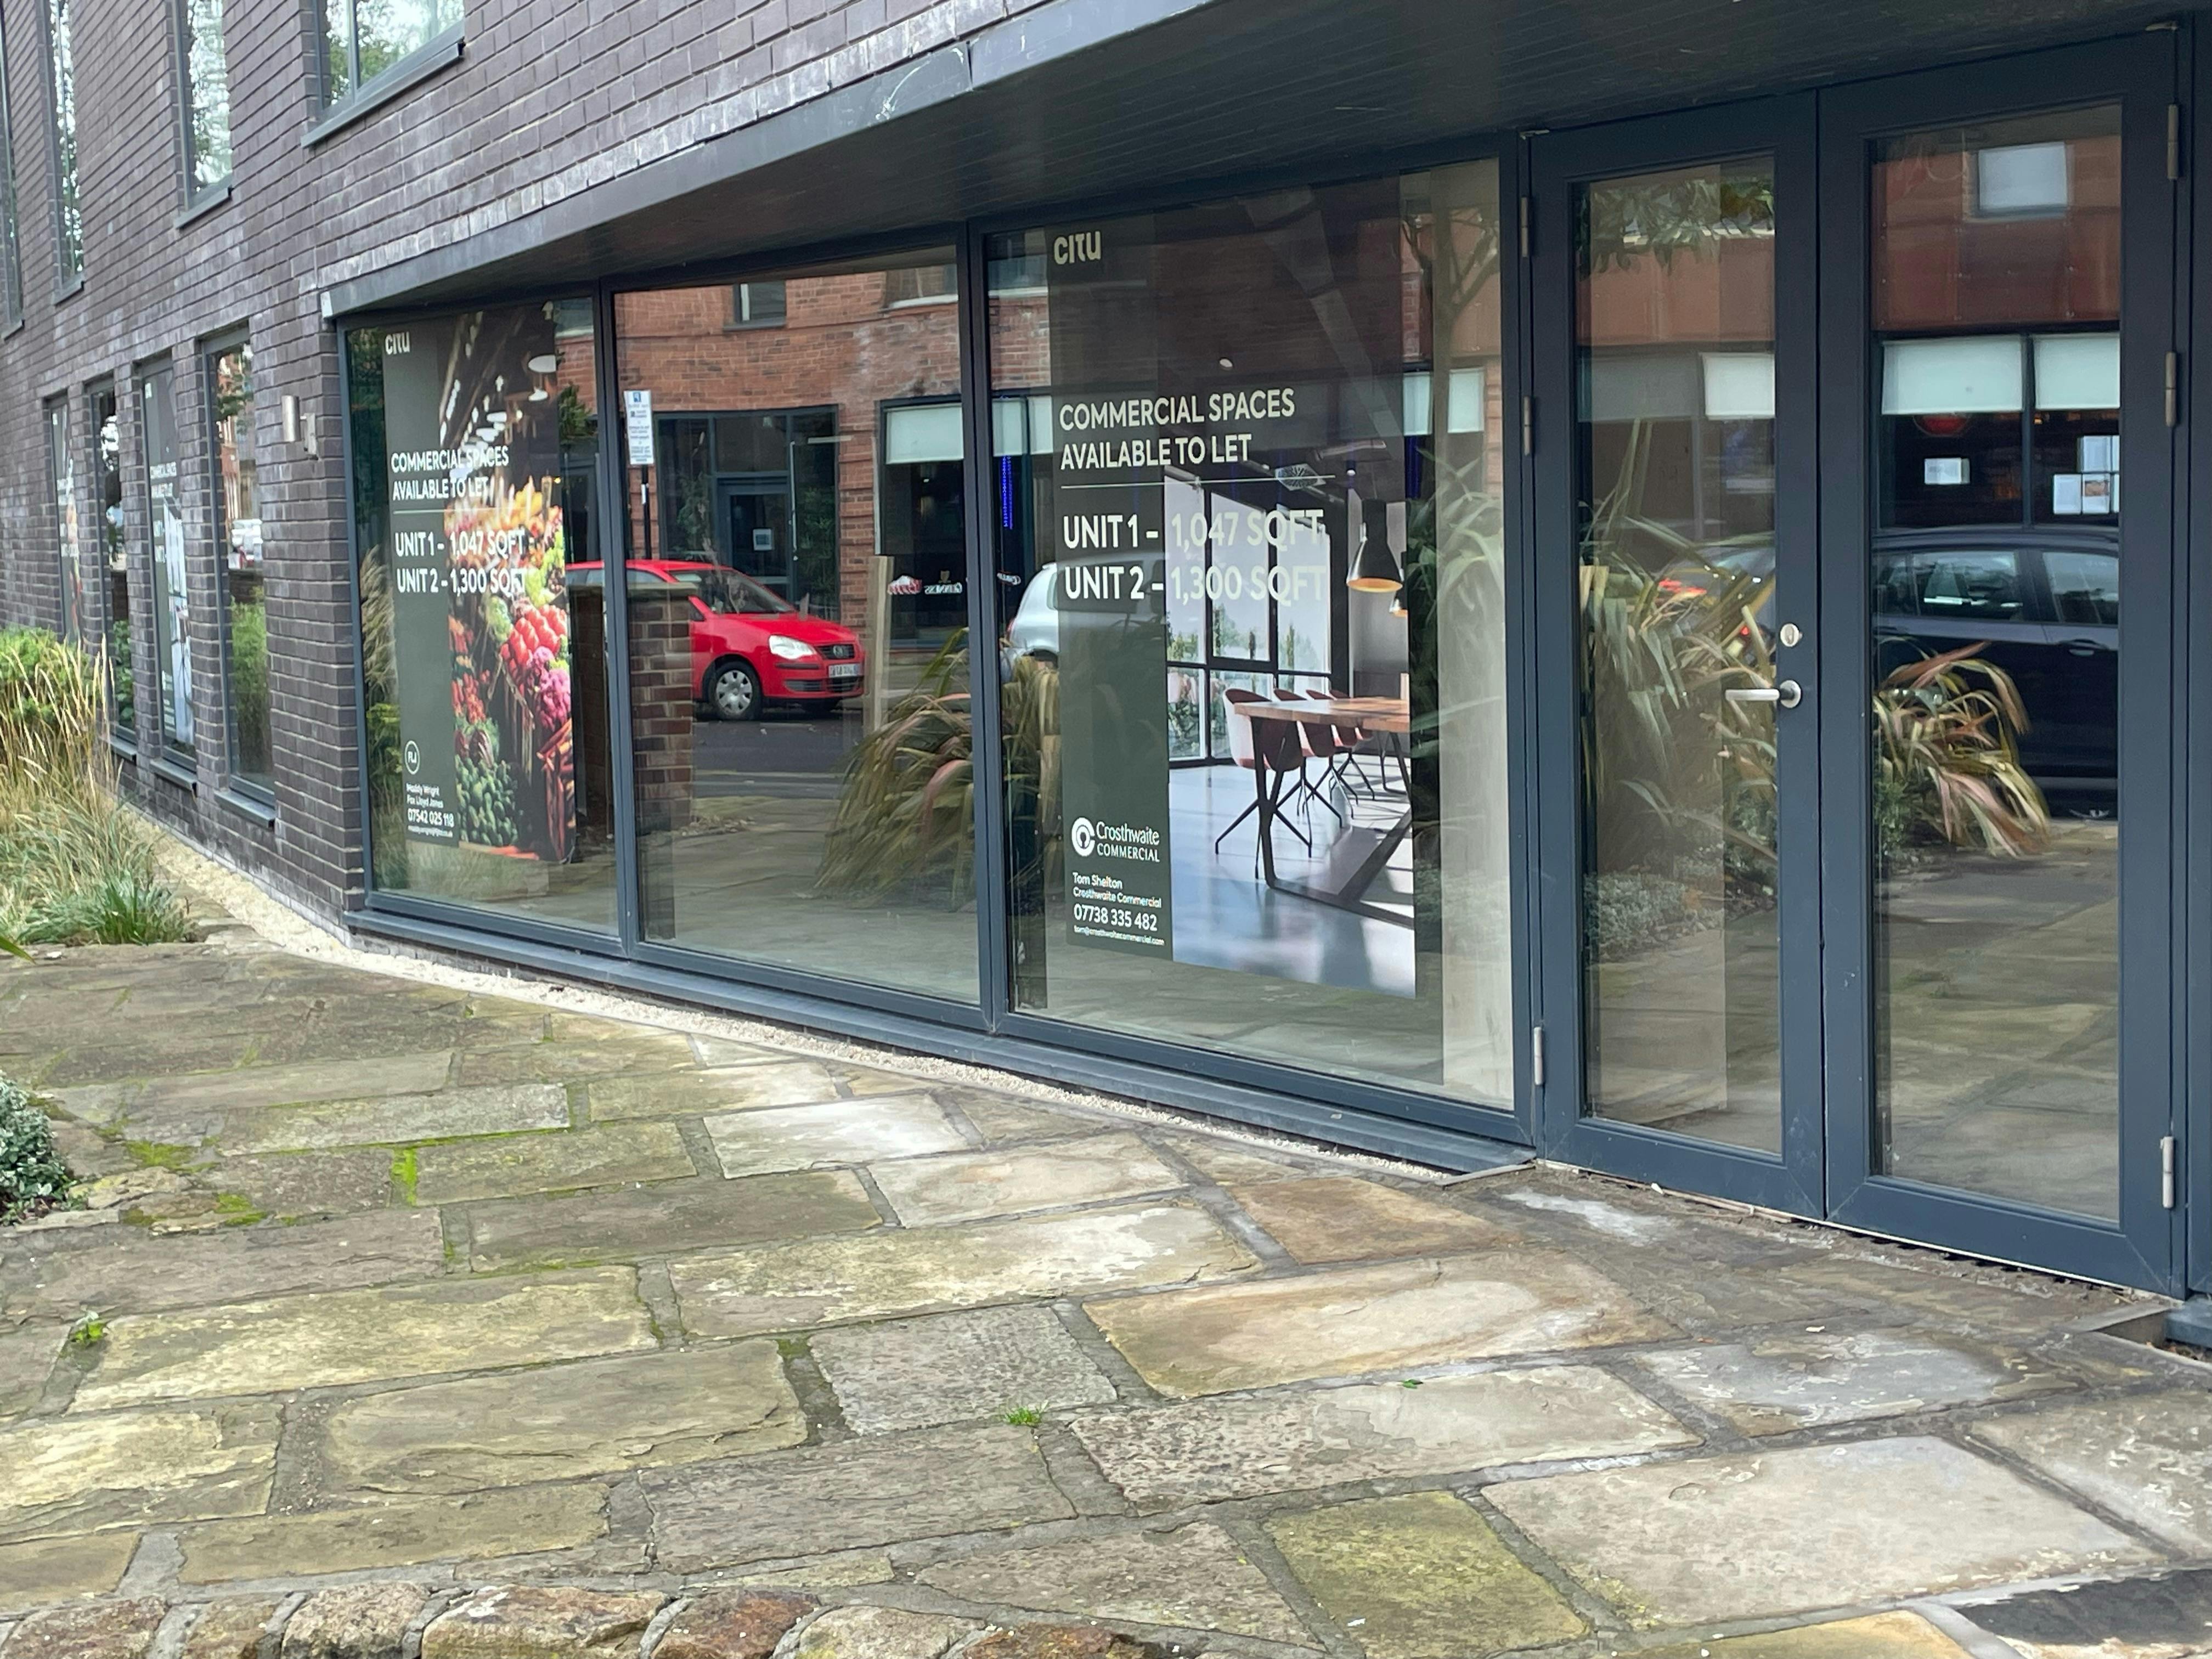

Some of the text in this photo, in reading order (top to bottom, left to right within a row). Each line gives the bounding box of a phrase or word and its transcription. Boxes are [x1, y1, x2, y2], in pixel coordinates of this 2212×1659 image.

[1059, 388, 1295, 431] COMMERCIAL SPACES
[391, 445, 509, 473] COMMERCIAL SPACES
[1060, 434, 1251, 470] AVAILABLE TO LET
[393, 476, 488, 500] AVAILABLE TO LET
[394, 531, 426, 557] UNIT
[428, 531, 435, 556] 1
[450, 530, 484, 560] 1,047
[487, 529, 526, 559] SQFT
[1063, 515, 1123, 549] UNIT
[1128, 514, 1138, 548] 1
[1171, 512, 1239, 552] 1,047
[1247, 509, 1324, 552] SQFT
[397, 568, 428, 593] UNIT
[430, 568, 439, 593] 2
[450, 568, 487, 597] 1,300
[490, 568, 527, 599] SQFT
[1064, 566, 1125, 599] UNIT
[1130, 566, 1145, 599] 2
[1171, 566, 1242, 606] 1,300
[1251, 565, 1327, 606] SQFT
[1097, 821, 1160, 845] Crosthwaite
[1097, 843, 1160, 862] COMMERCIAL
[1073, 872, 1123, 889] Tom Shelton
[1073, 887, 1162, 909] Crosthwaite Commercial
[1074, 903, 1158, 932] 07738 335 482
